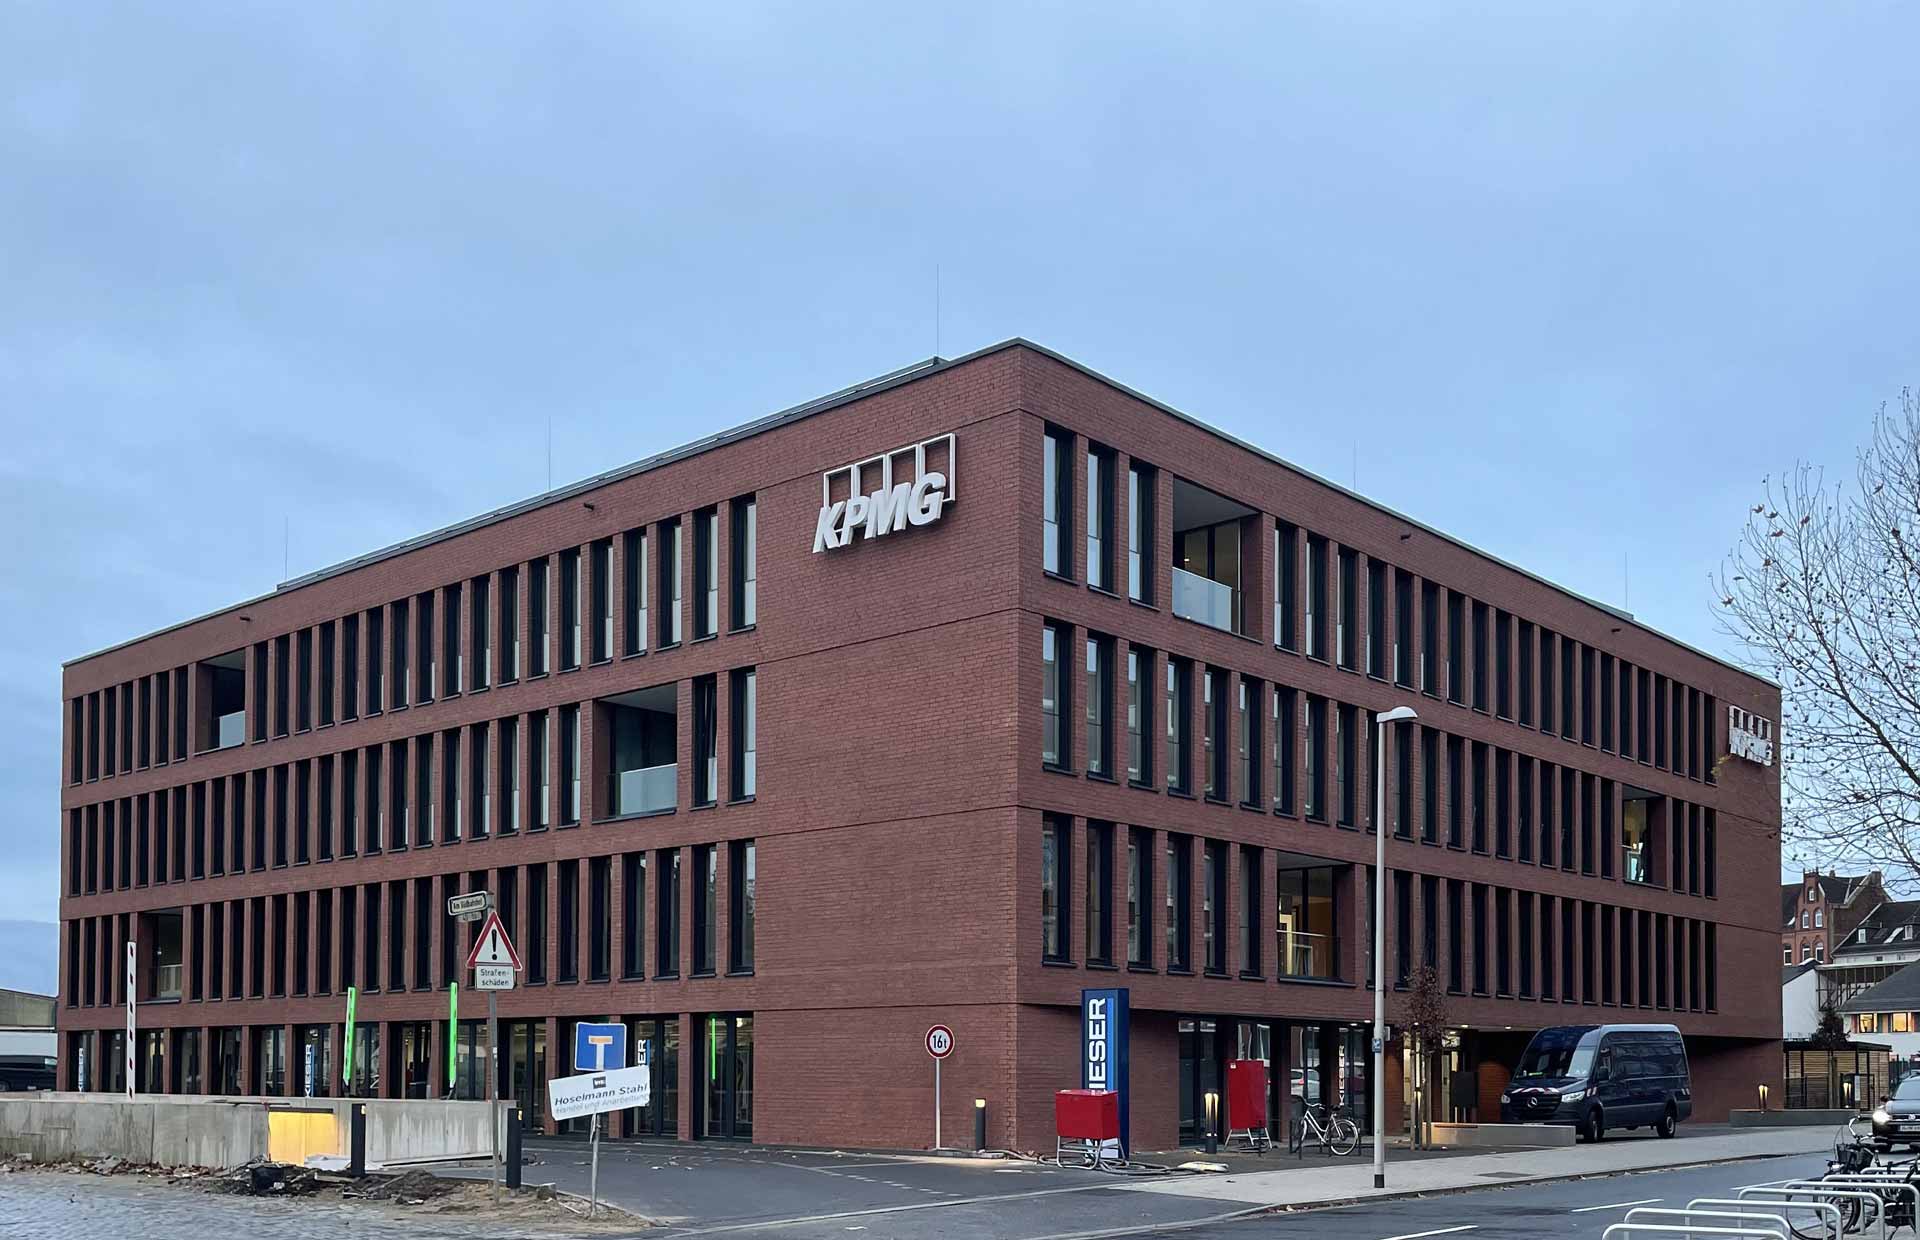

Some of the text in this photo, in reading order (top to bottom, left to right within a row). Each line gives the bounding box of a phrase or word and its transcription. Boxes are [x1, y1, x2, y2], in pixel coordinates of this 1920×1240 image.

[812, 472, 947, 553] KPMG
[637, 1039, 647, 1065] ER
[1088, 998, 1106, 1090] IESER
[619, 1082, 648, 1096] Stahl
